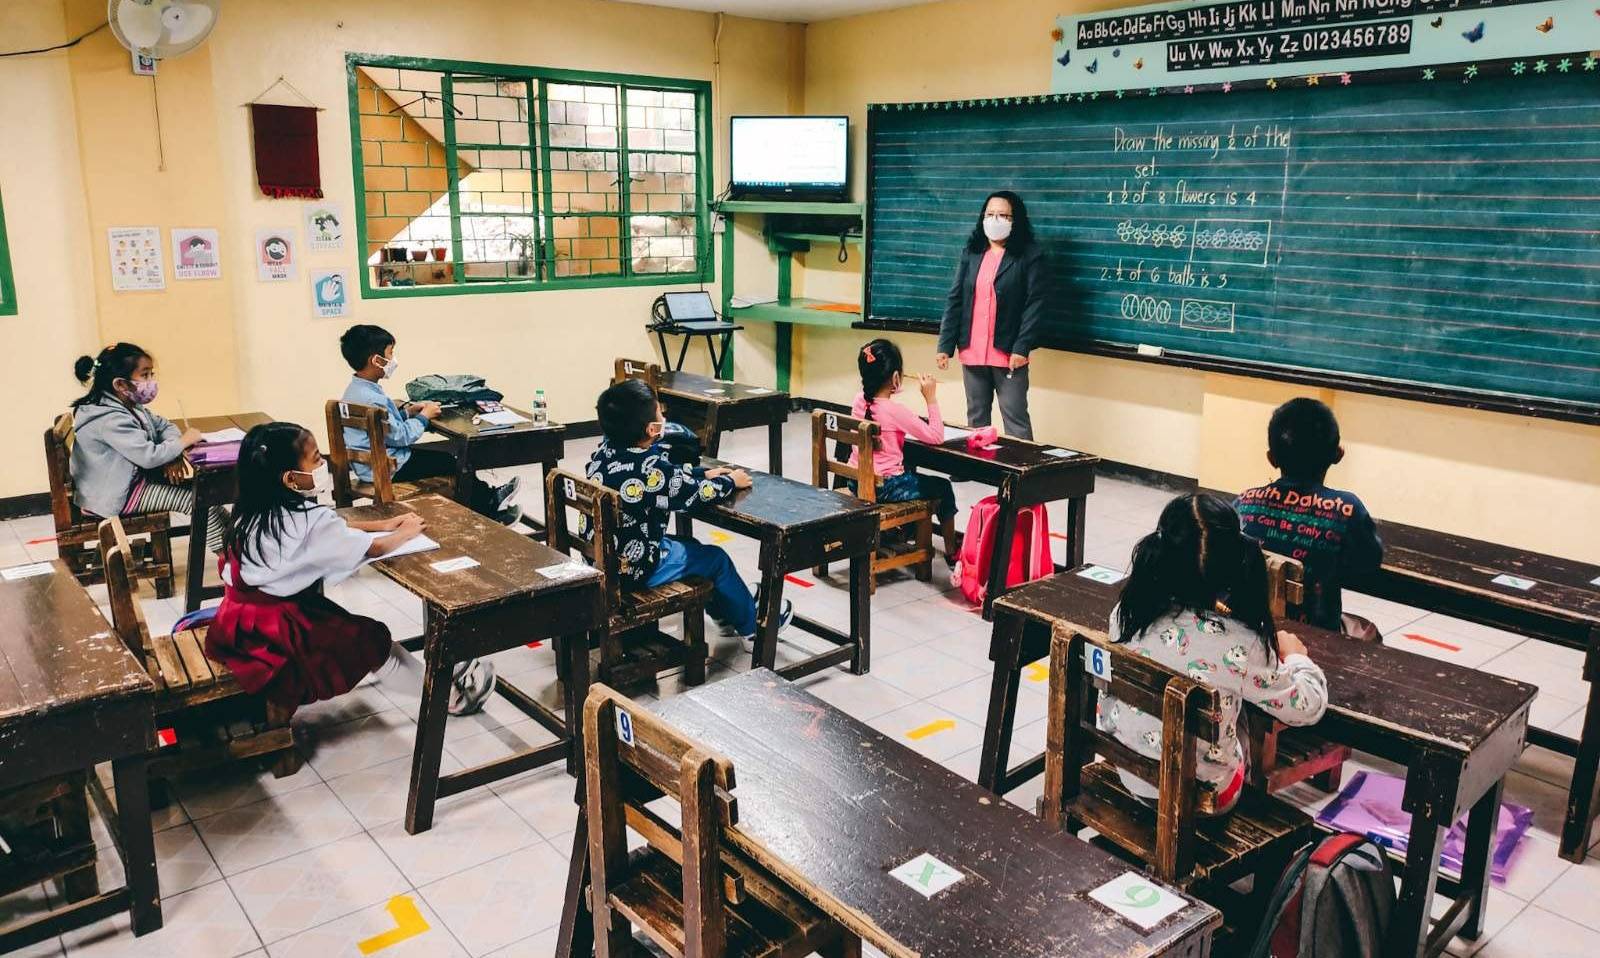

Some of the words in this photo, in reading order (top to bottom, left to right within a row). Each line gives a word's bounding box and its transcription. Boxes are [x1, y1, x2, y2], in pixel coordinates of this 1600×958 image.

[1078, 23, 1093, 41] Aa
[1094, 21, 1108, 39] Bb
[1109, 20, 1122, 36] Cc
[1123, 18, 1138, 35] Dd
[1139, 16, 1152, 34] Ee
[1166, 14, 1186, 33] Gg
[1187, 10, 1207, 28] Hh
[1208, 7, 1220, 26] Ii
[1223, 6, 1235, 28] Jj
[1239, 3, 1258, 23] Kk
[1262, 1, 1275, 20] Ll
[1281, 0, 1306, 18] Mm
[1308, 0, 1331, 15] Nn
[1169, 44, 1187, 62] Uu
[1189, 42, 1205, 61] Vv
[1208, 41, 1233, 59] Ww
[1236, 38, 1255, 57] Xx
[1257, 36, 1274, 59] Yy
[1280, 34, 1299, 53] Zz
[1303, 23, 1411, 52] 0123456789
[1113, 126, 1145, 153] Draw
[1152, 125, 1173, 151] the
[1178, 130, 1220, 159] missing
[1243, 125, 1262, 148] of
[1265, 124, 1290, 148] the
[1134, 156, 1159, 179] set.
[1132, 181, 1150, 204] of
[1158, 191, 1166, 204] 8
[1174, 179, 1216, 205] flowers
[1225, 184, 1237, 205] is
[1246, 190, 1257, 207] 4
[1129, 260, 1145, 282] of
[1151, 266, 1160, 283] 6
[1168, 263, 1195, 287] balls
[1200, 268, 1210, 286] is
[1216, 273, 1228, 289] 3
[829, 415, 835, 430] 2
[1284, 490, 1354, 517] Dakota
[1257, 514, 1276, 527] Can
[1279, 519, 1293, 531] Be
[1297, 524, 1322, 540] Only
[1092, 648, 1104, 675] 6
[619, 712, 631, 743] 9
